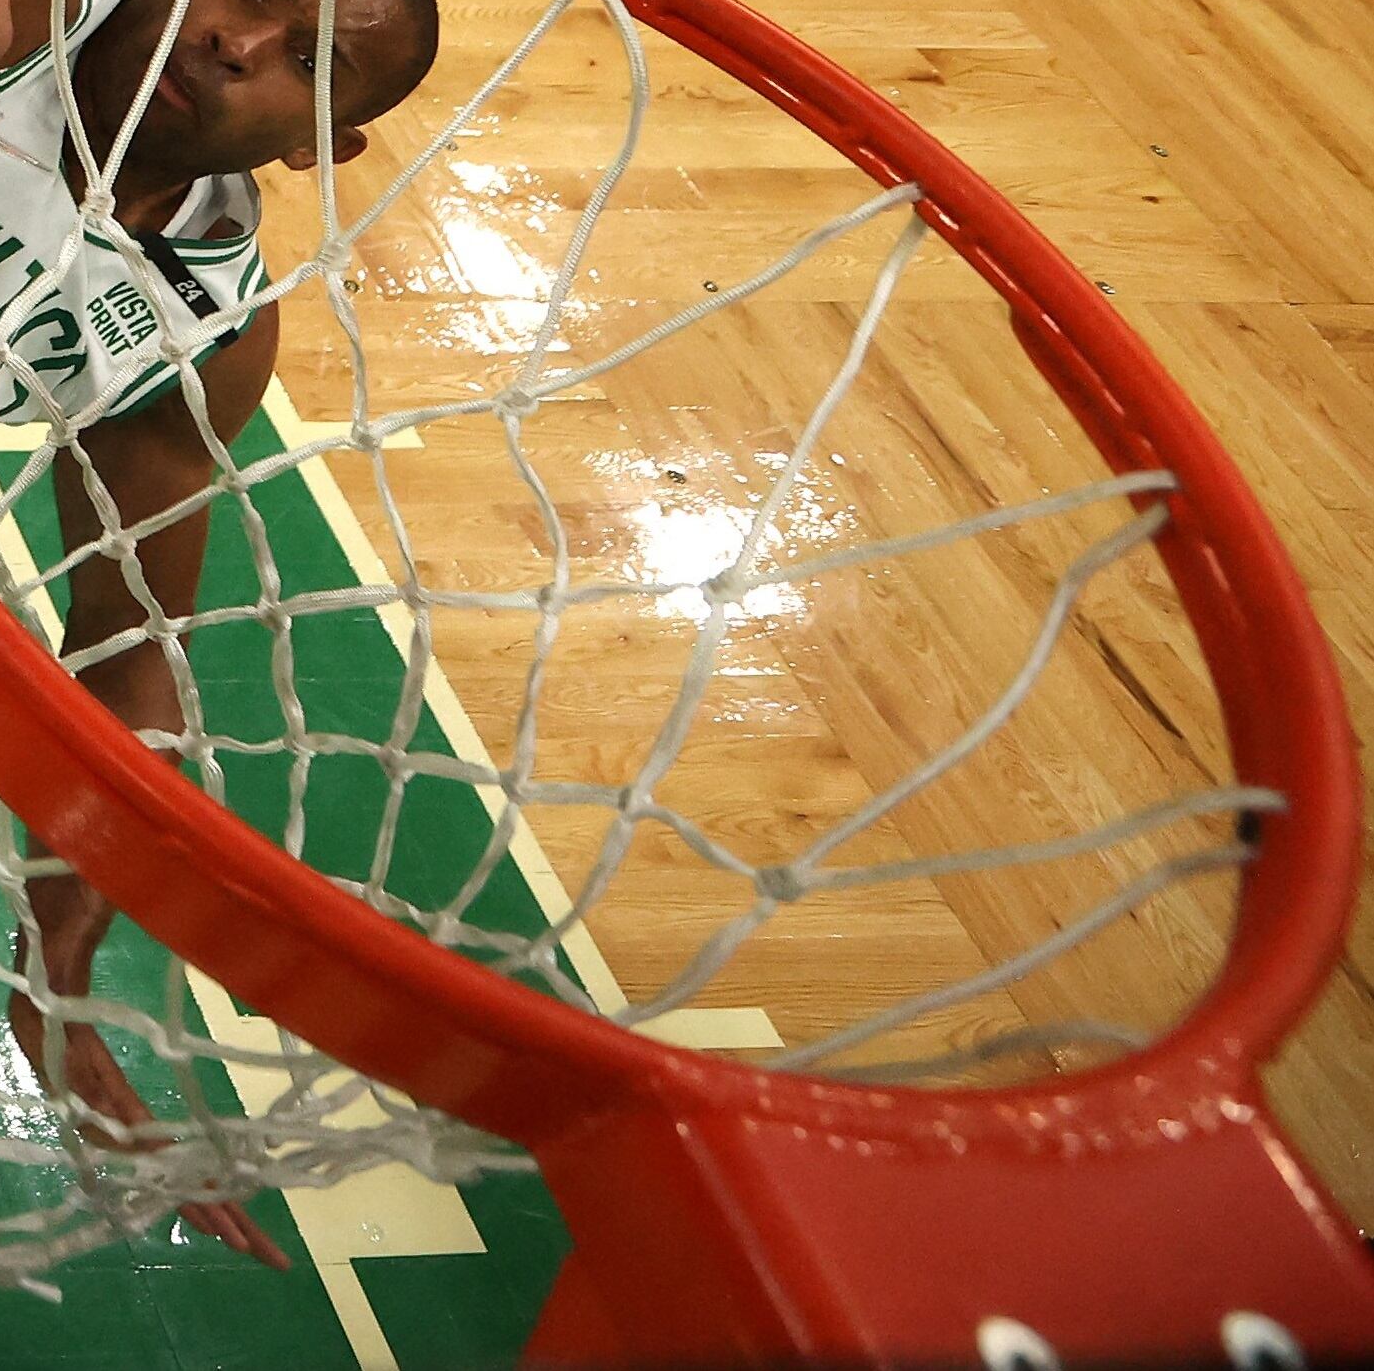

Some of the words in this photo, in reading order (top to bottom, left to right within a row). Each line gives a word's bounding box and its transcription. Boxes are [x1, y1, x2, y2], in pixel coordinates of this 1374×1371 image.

[103, 282, 158, 342] VISTA
[175, 280, 204, 304] 24
[86, 297, 134, 357] PRINT
